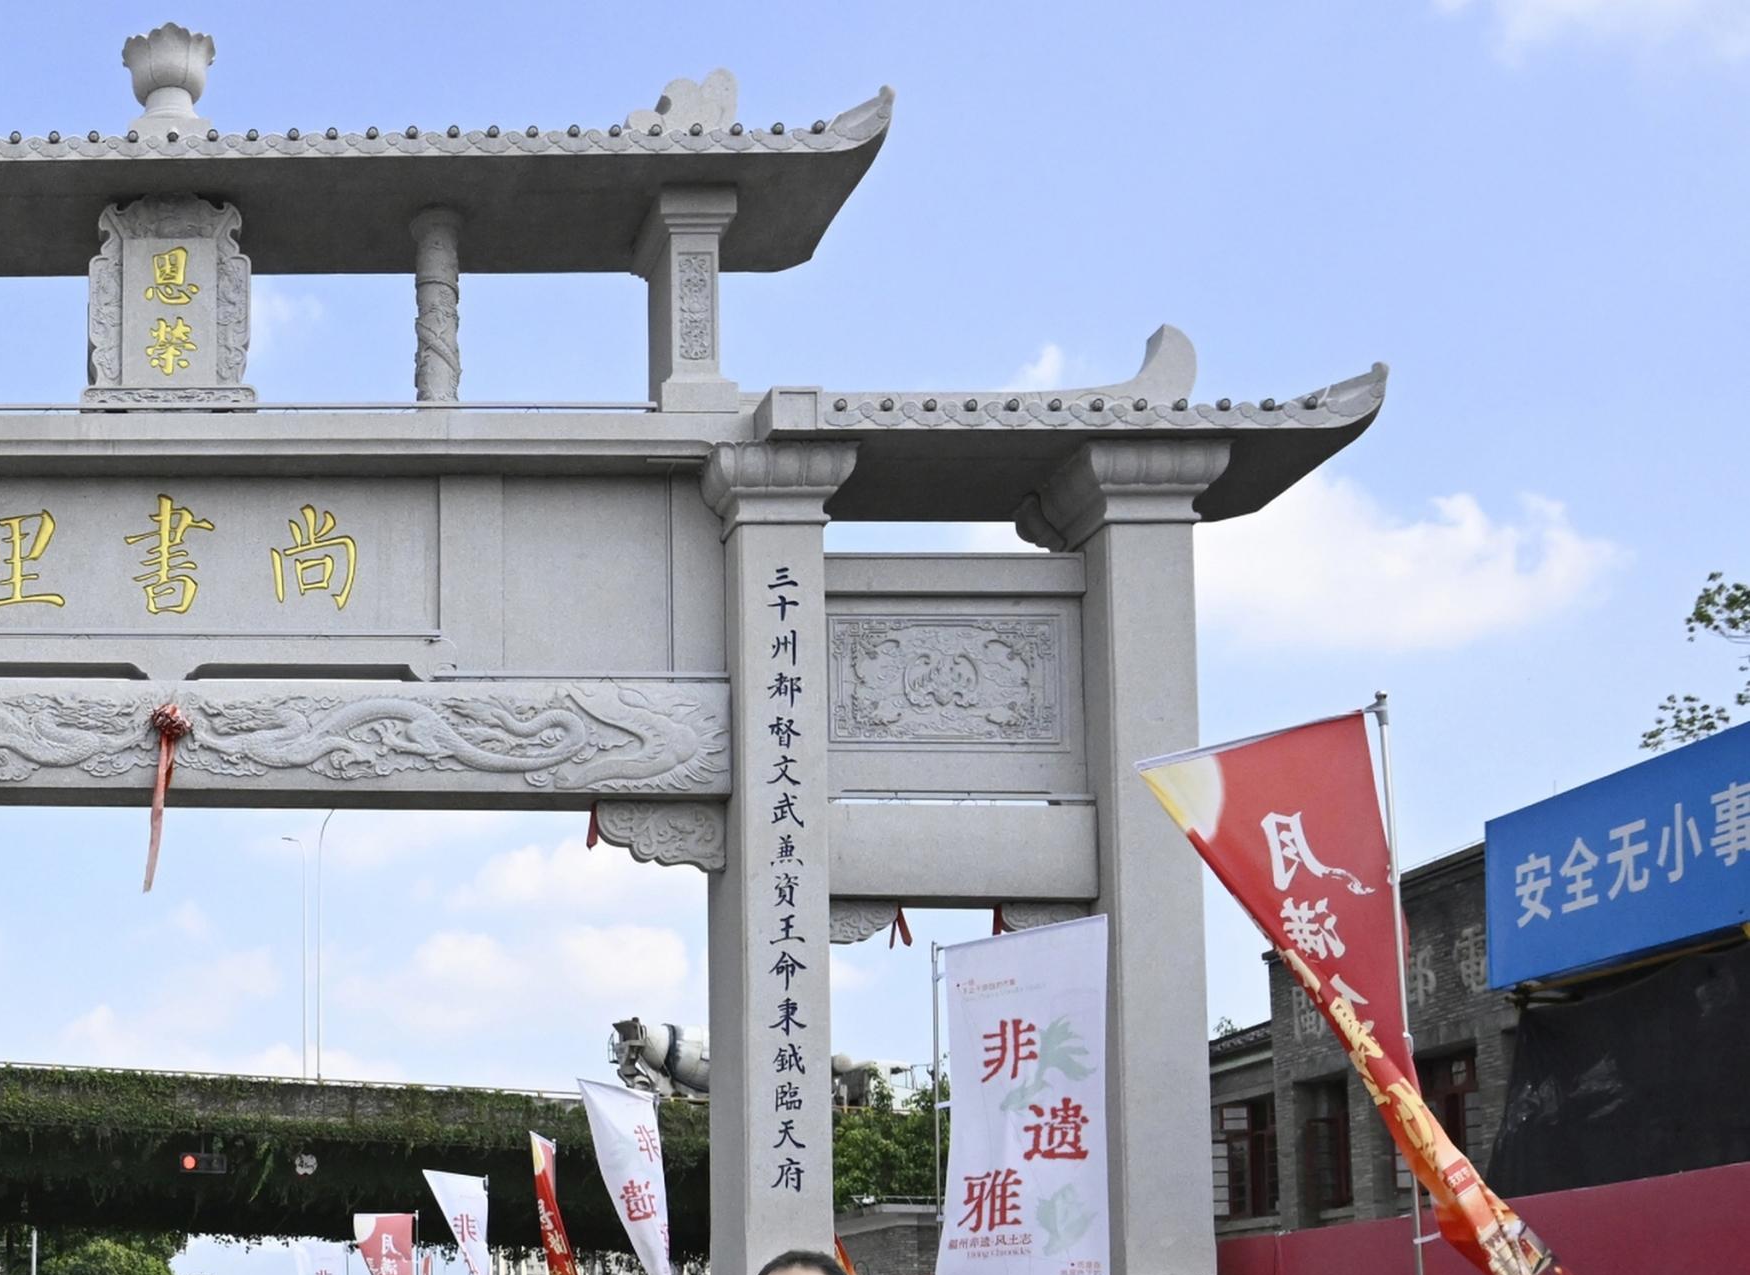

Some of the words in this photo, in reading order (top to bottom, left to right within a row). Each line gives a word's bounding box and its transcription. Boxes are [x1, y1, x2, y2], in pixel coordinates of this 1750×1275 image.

[1515, 782, 1750, 929] 安全无小事
